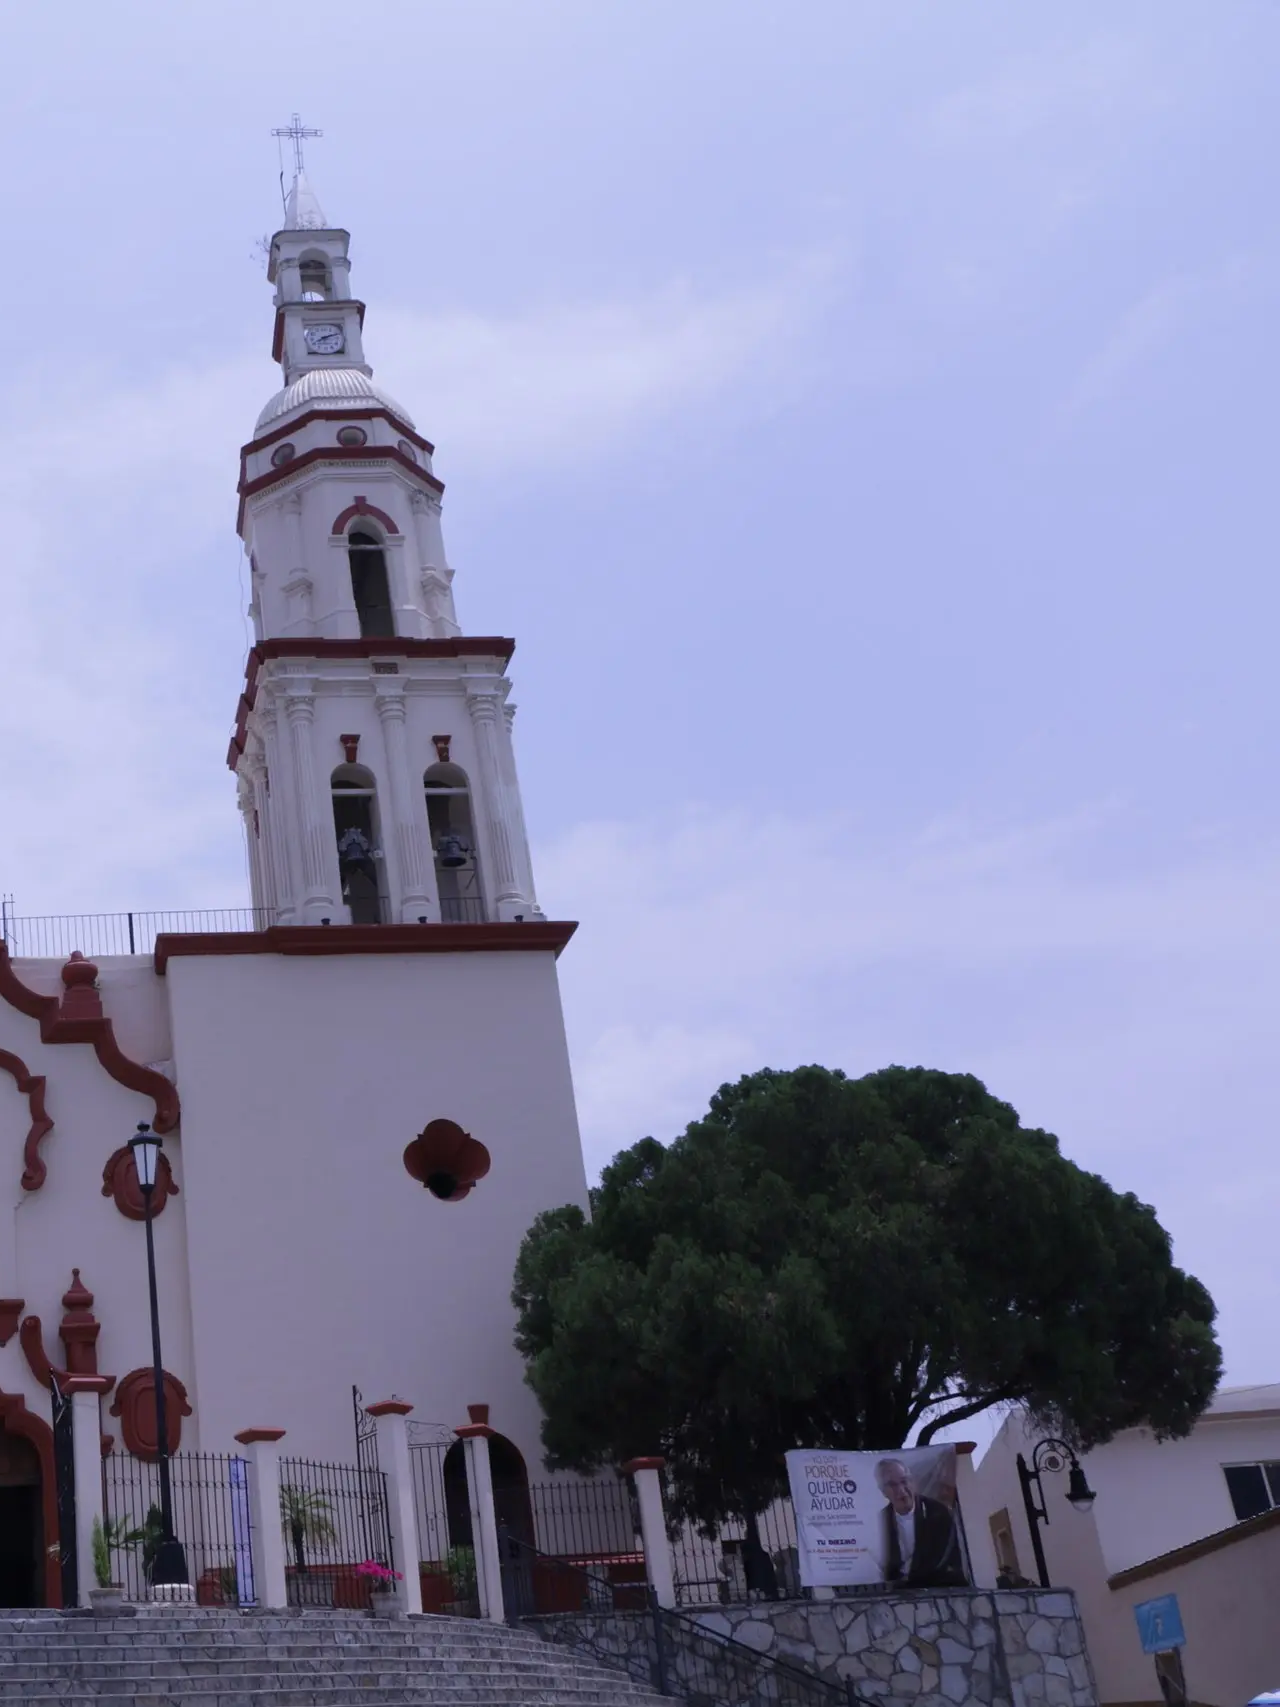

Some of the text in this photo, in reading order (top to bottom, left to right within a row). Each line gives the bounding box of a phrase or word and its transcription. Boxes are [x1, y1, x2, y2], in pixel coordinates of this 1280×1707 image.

[805, 1465, 850, 1480] PORQUE
[808, 1480, 857, 1497] QUIERO
[811, 1497, 854, 1511] AYUDAR
